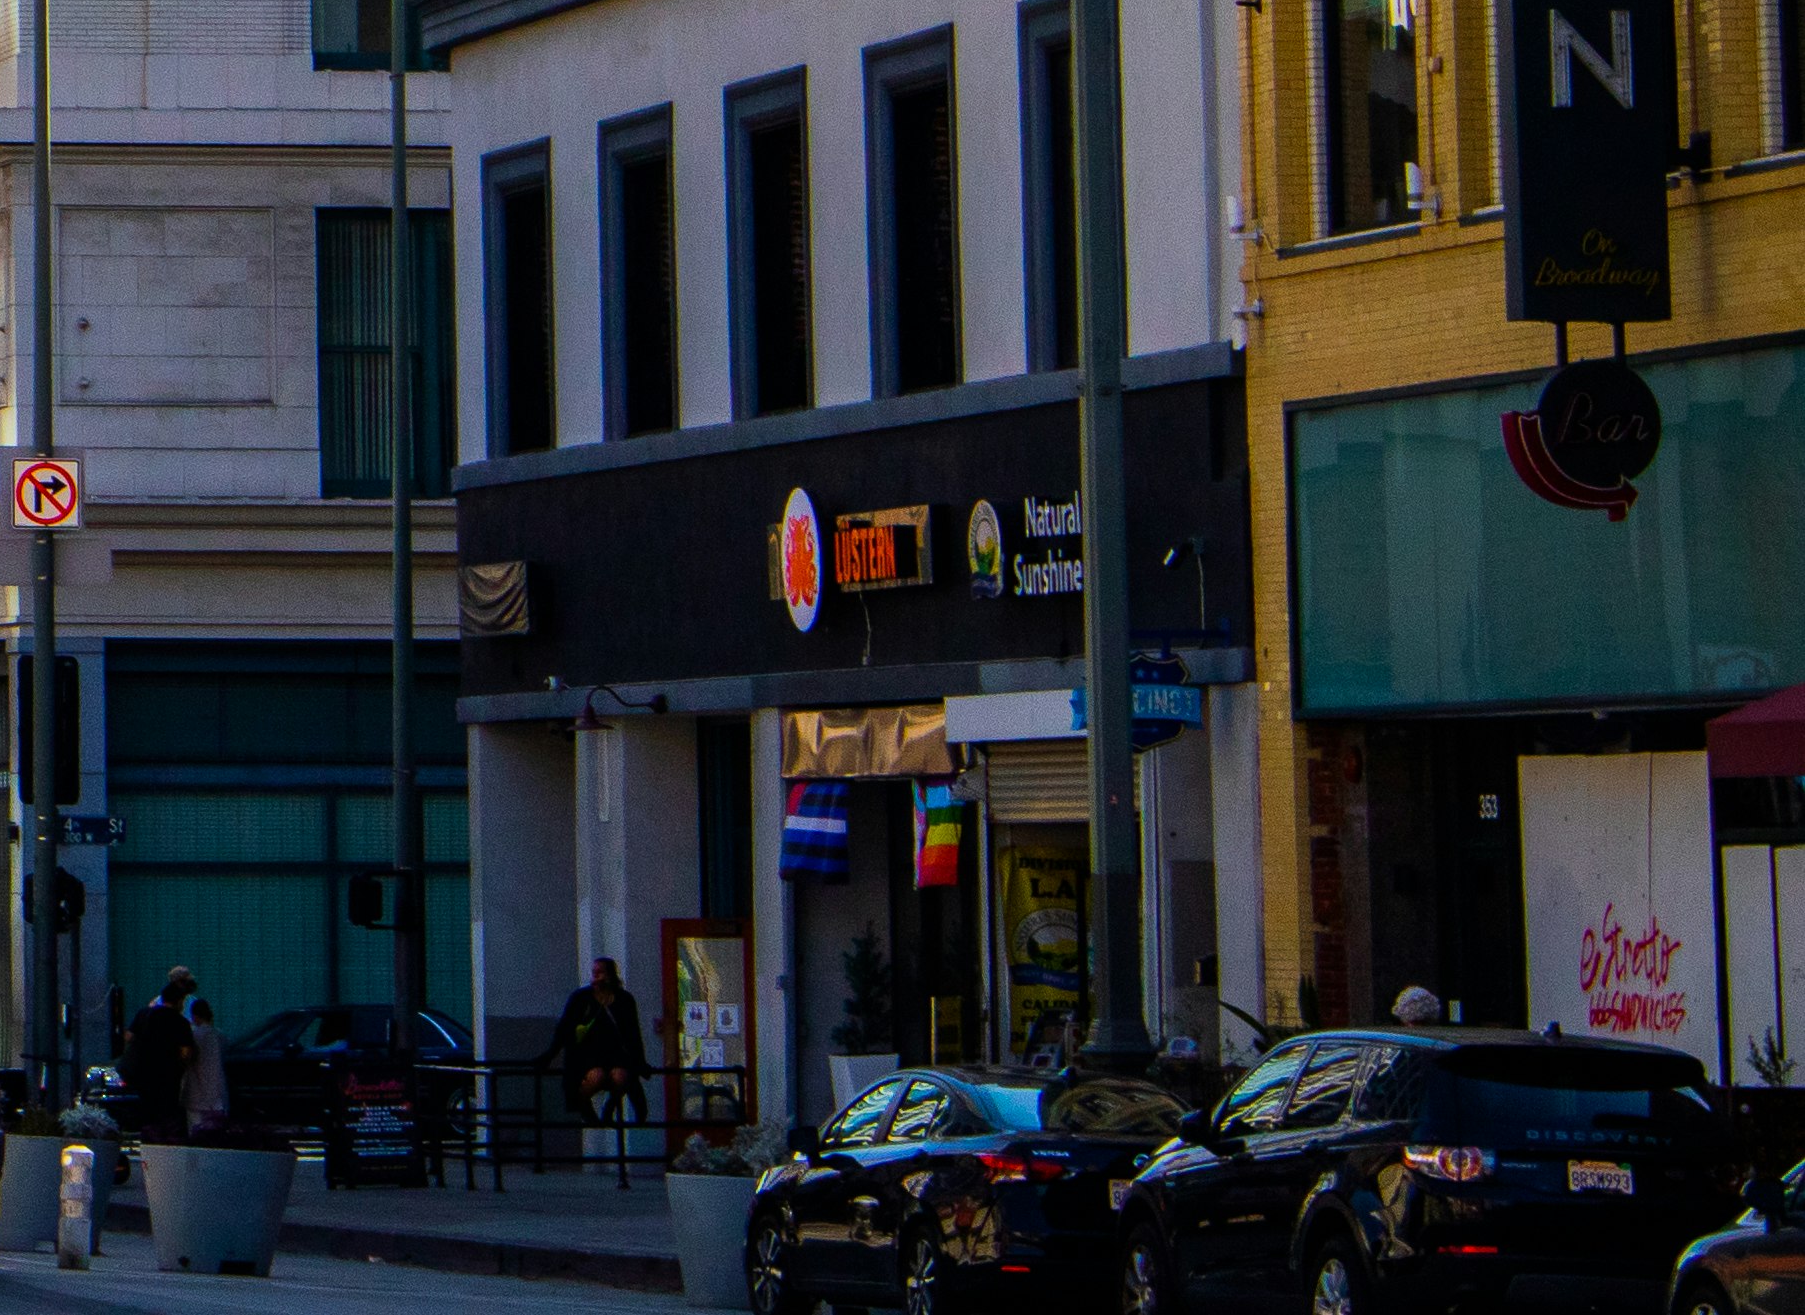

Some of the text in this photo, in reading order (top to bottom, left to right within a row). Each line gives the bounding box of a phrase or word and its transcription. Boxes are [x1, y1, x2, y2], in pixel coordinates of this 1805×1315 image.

[1580, 228, 1618, 258] On
[1533, 256, 1662, 296] Broadway
[1555, 391, 1649, 445] Bar
[1024, 489, 1082, 538] Natural
[1013, 553, 1083, 597] Sunshine
[109, 817, 123, 833] St
